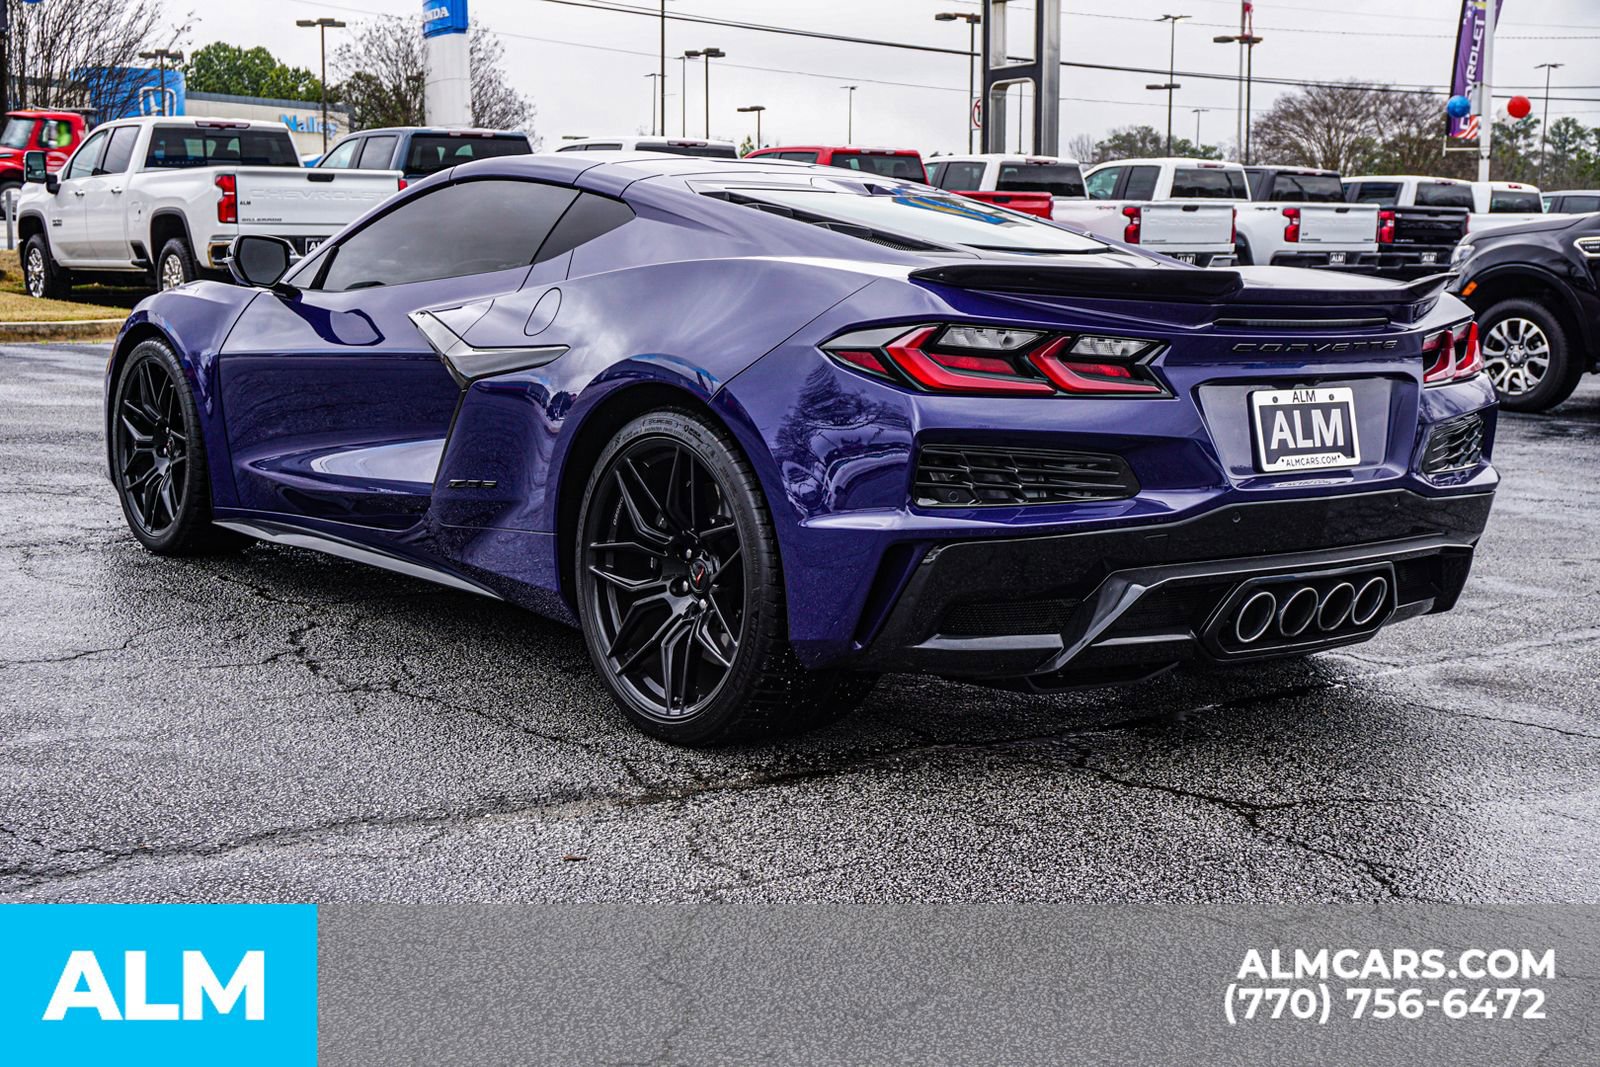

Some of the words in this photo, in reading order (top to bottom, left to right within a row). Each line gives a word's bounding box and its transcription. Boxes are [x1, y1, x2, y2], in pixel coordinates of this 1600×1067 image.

[1231, 339, 1399, 352] CORVETTE
[1292, 390, 1317, 403] ALM
[1270, 408, 1345, 450] ALM
[1285, 455, 1338, 467] ALMCARS.COM
